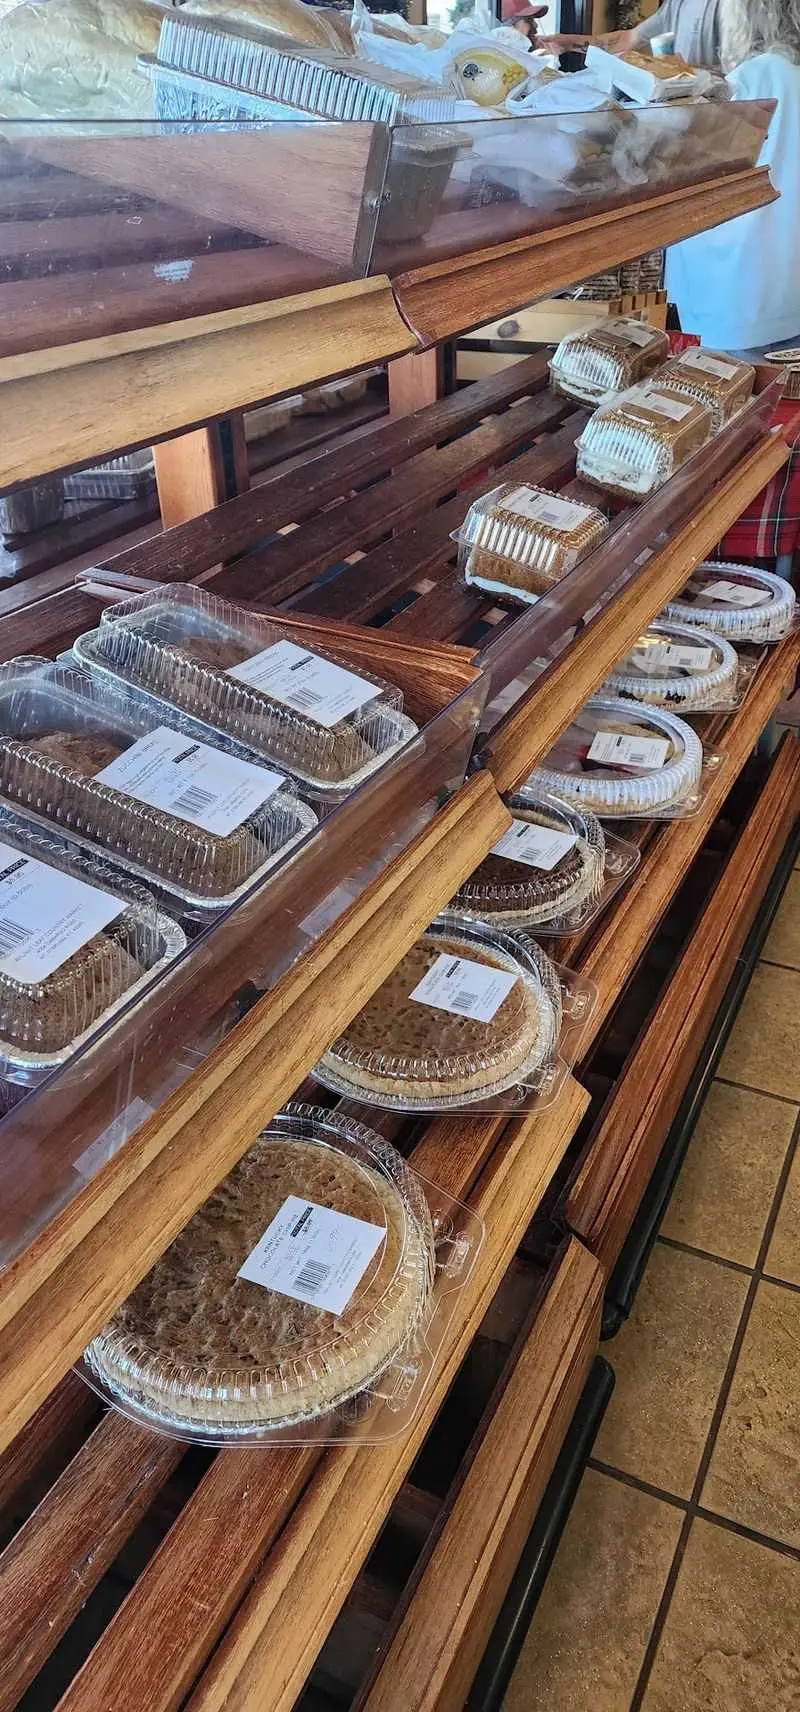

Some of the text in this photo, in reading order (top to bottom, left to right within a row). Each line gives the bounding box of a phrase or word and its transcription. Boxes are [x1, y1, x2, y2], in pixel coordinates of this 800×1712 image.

[290, 1220, 304, 1236] TOTAL
[299, 1207, 313, 1222] PRICE
[258, 1236, 285, 1270] CHOCOLATE
[263, 1224, 285, 1254] KENTUCKY
